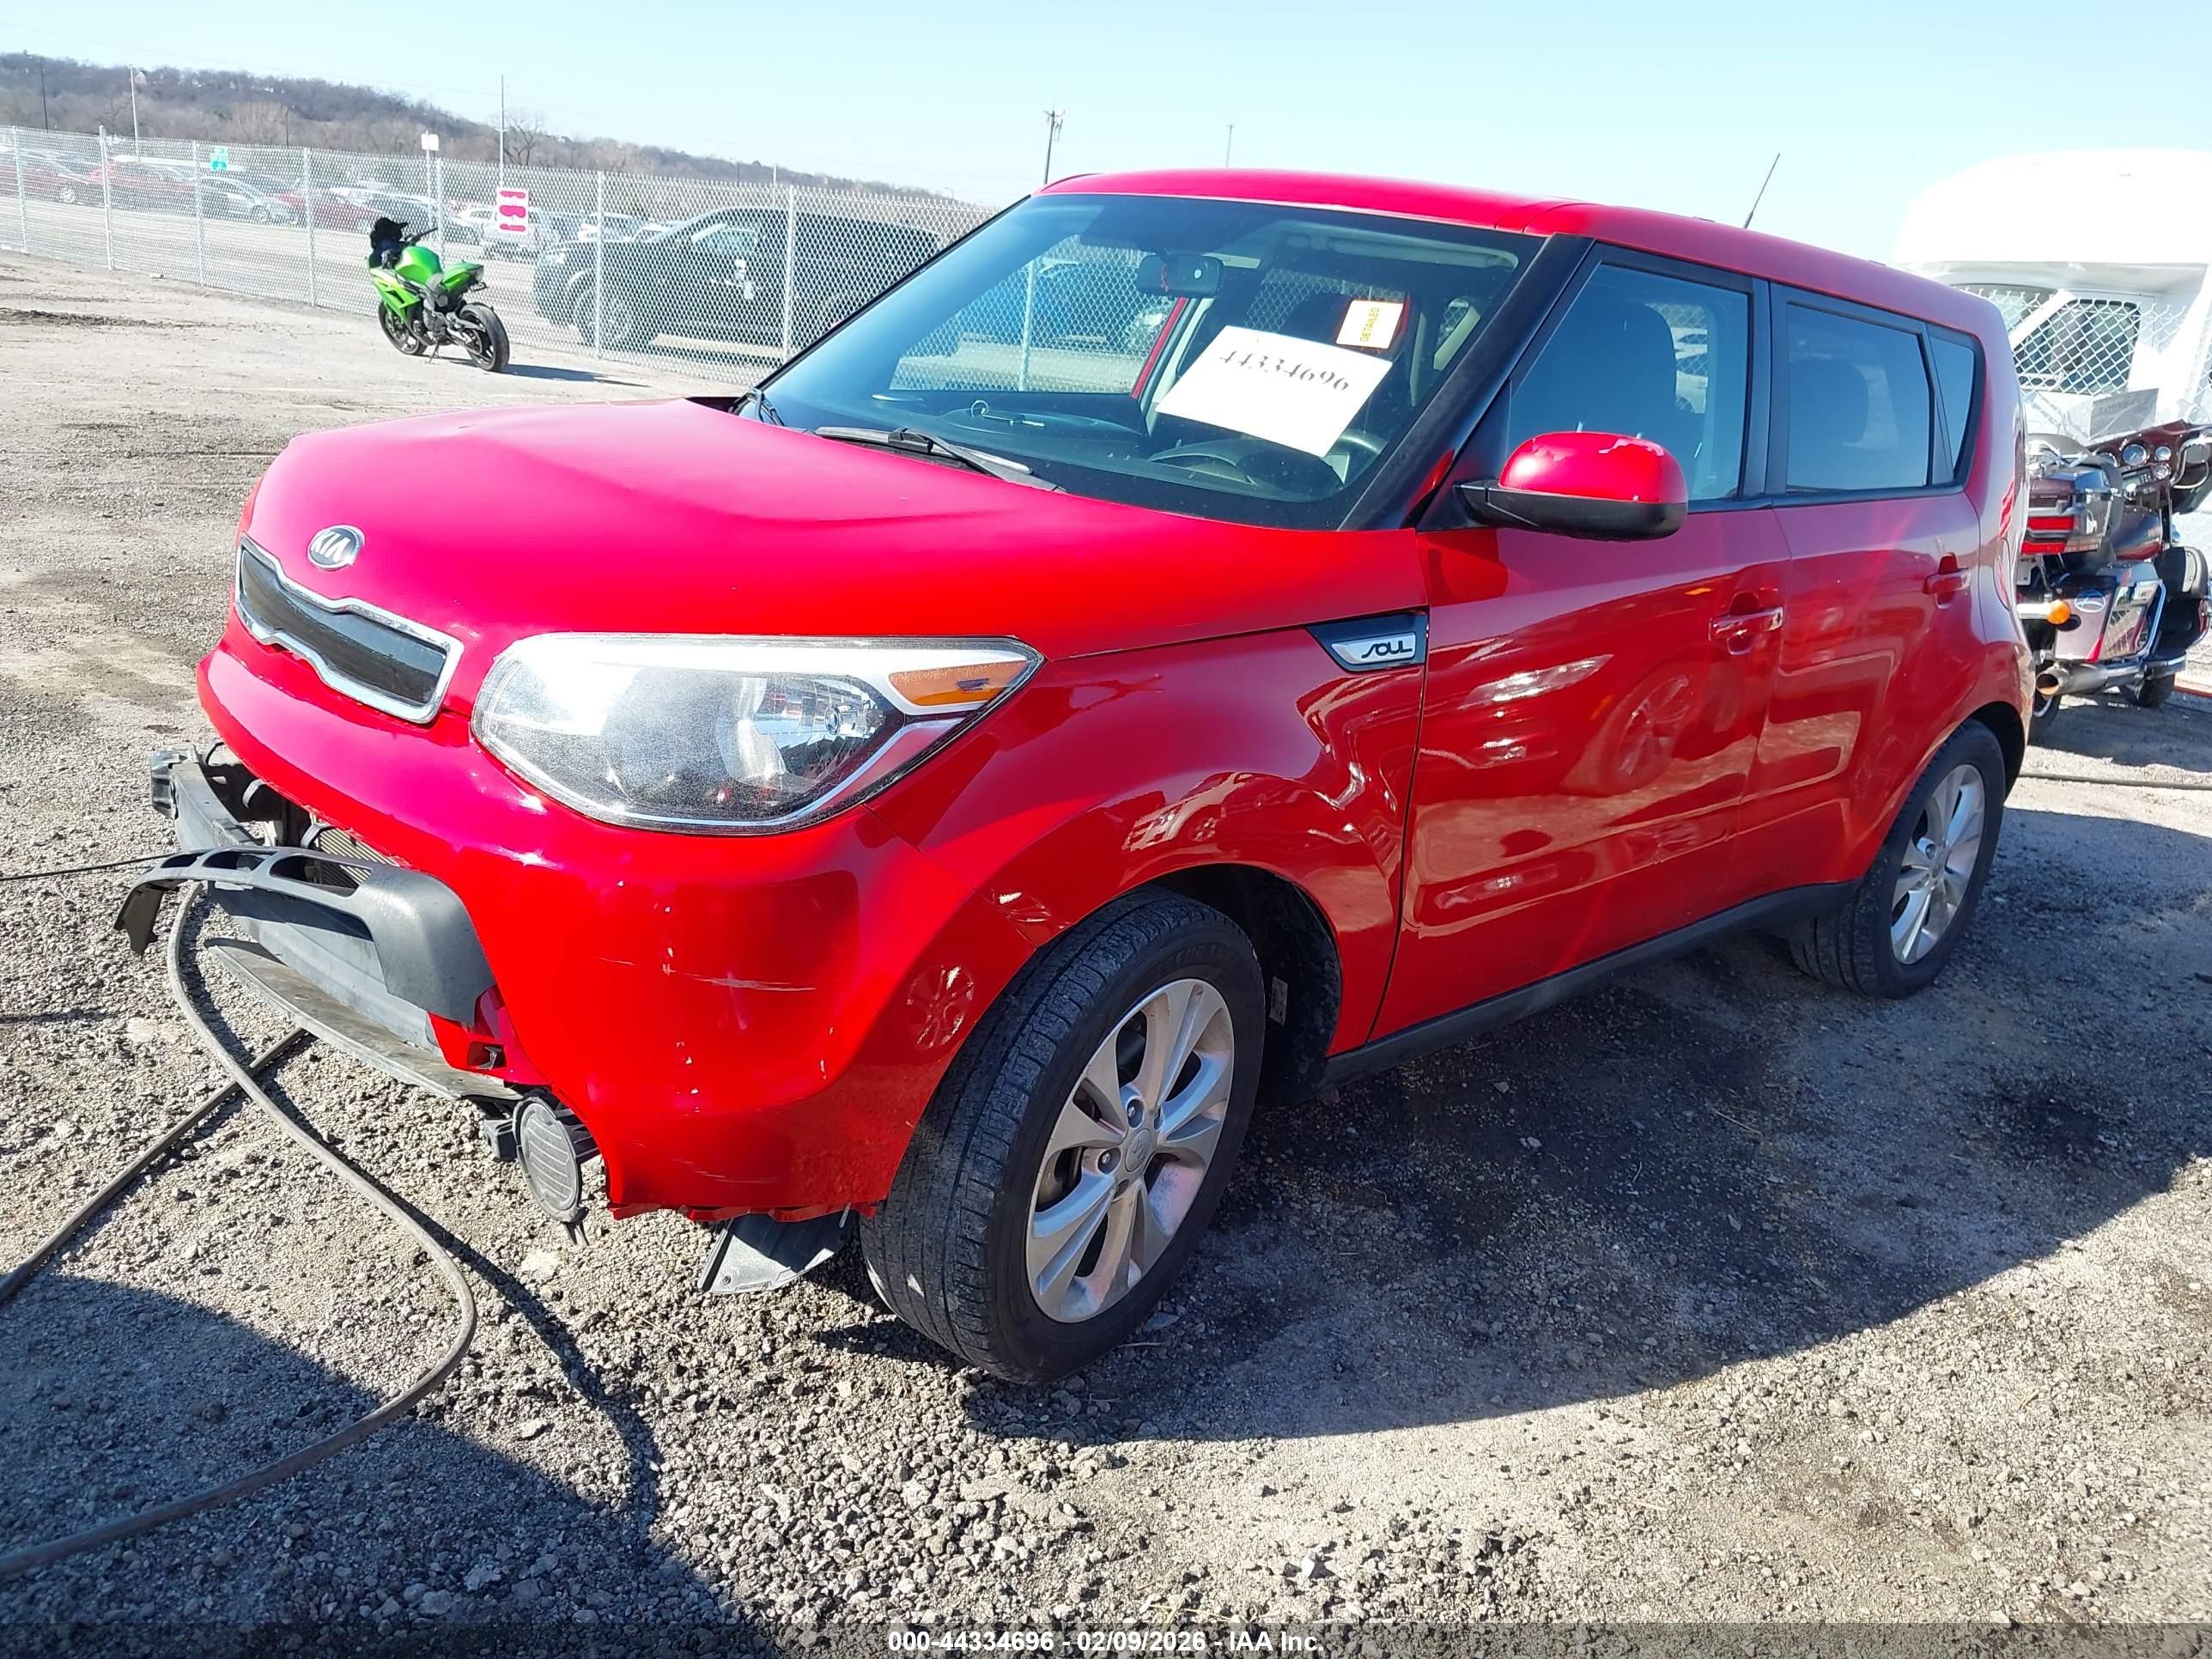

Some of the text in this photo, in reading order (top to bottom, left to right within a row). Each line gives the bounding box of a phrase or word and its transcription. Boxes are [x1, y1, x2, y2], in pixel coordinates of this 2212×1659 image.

[1360, 307, 1380, 342] DETAILED
[1219, 350, 1349, 391] 44334696
[310, 531, 351, 563] KIA
[1361, 640, 1413, 659] SOUL
